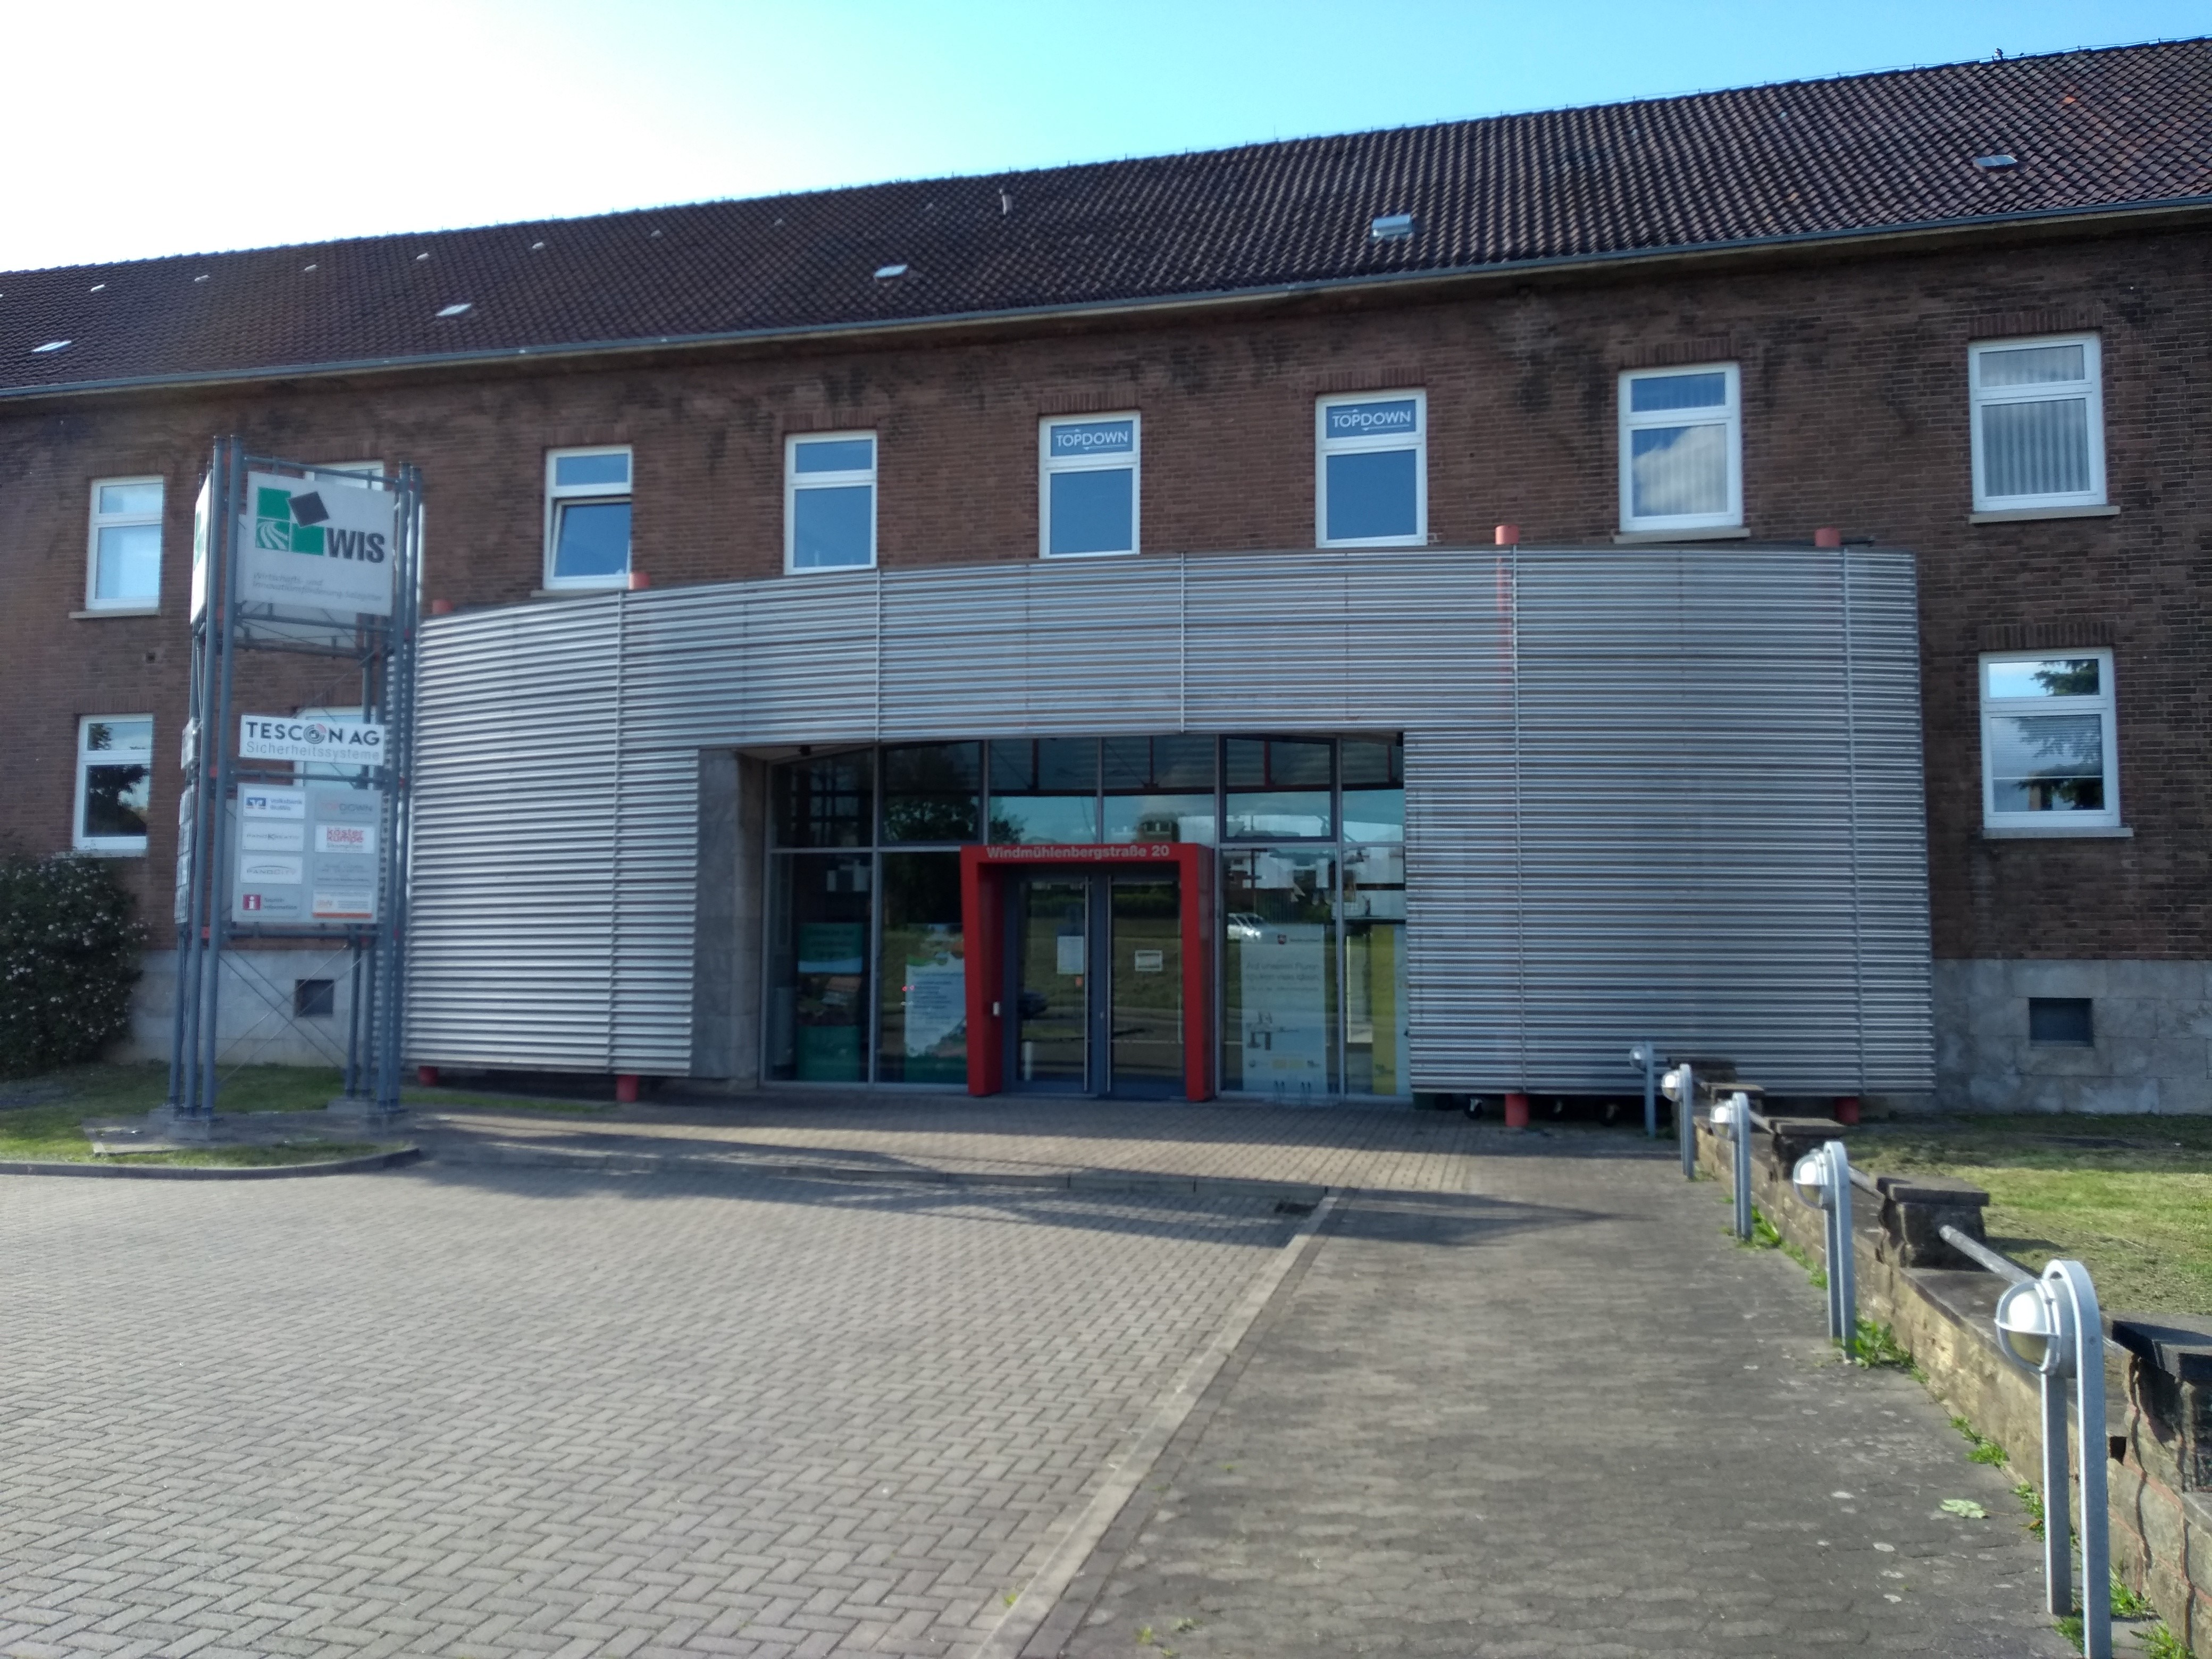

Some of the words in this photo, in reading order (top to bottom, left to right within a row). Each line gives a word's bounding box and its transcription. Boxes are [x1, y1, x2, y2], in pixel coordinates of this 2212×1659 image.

[1332, 410, 1411, 428] TOPDOWN
[1055, 430, 1128, 447] TOPDOWN
[326, 527, 385, 563] WIS
[245, 721, 343, 745] TESCON
[349, 730, 380, 746] AG
[246, 741, 380, 763] Sicherheitssysteme
[986, 845, 1147, 860] Windmühlenbergstraße
[1151, 844, 1170, 858] 20
